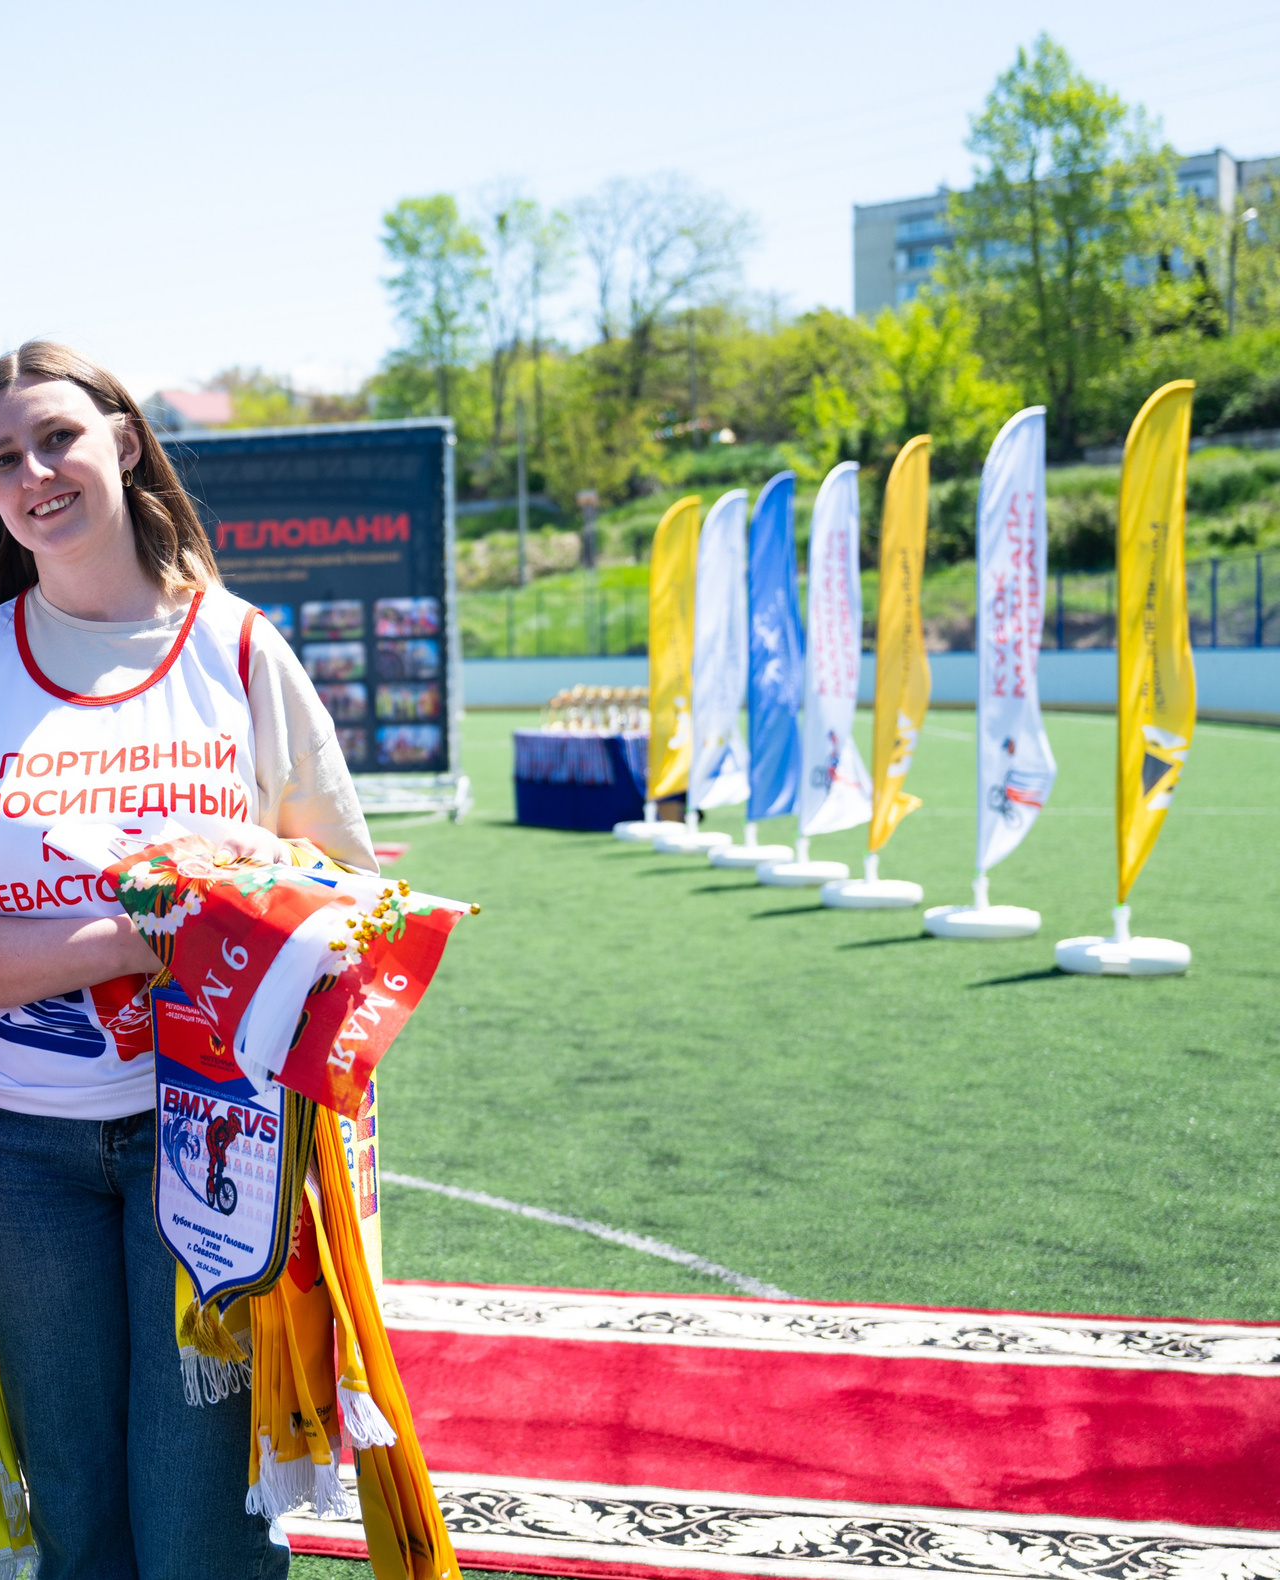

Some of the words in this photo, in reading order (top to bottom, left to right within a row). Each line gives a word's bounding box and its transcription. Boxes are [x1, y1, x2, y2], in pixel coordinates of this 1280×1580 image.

[216, 513, 410, 549] ГЕЛОВАНИ
[222, 938, 249, 971] 9
[383, 971, 409, 991] 9
[165, 1011, 195, 1023] «ФЕДЕРАЦИЯ
[326, 990, 396, 1074] МАЯ
[163, 1087, 218, 1122] BMX
[227, 1106, 278, 1143] SVS
[172, 1213, 192, 1228] Кубок
[192, 1223, 223, 1240] маршала
[223, 1234, 254, 1254] Геловани
[206, 1240, 221, 1252] этап
[186, 1242, 192, 1250] г.
[192, 1245, 234, 1268] Севастополь
